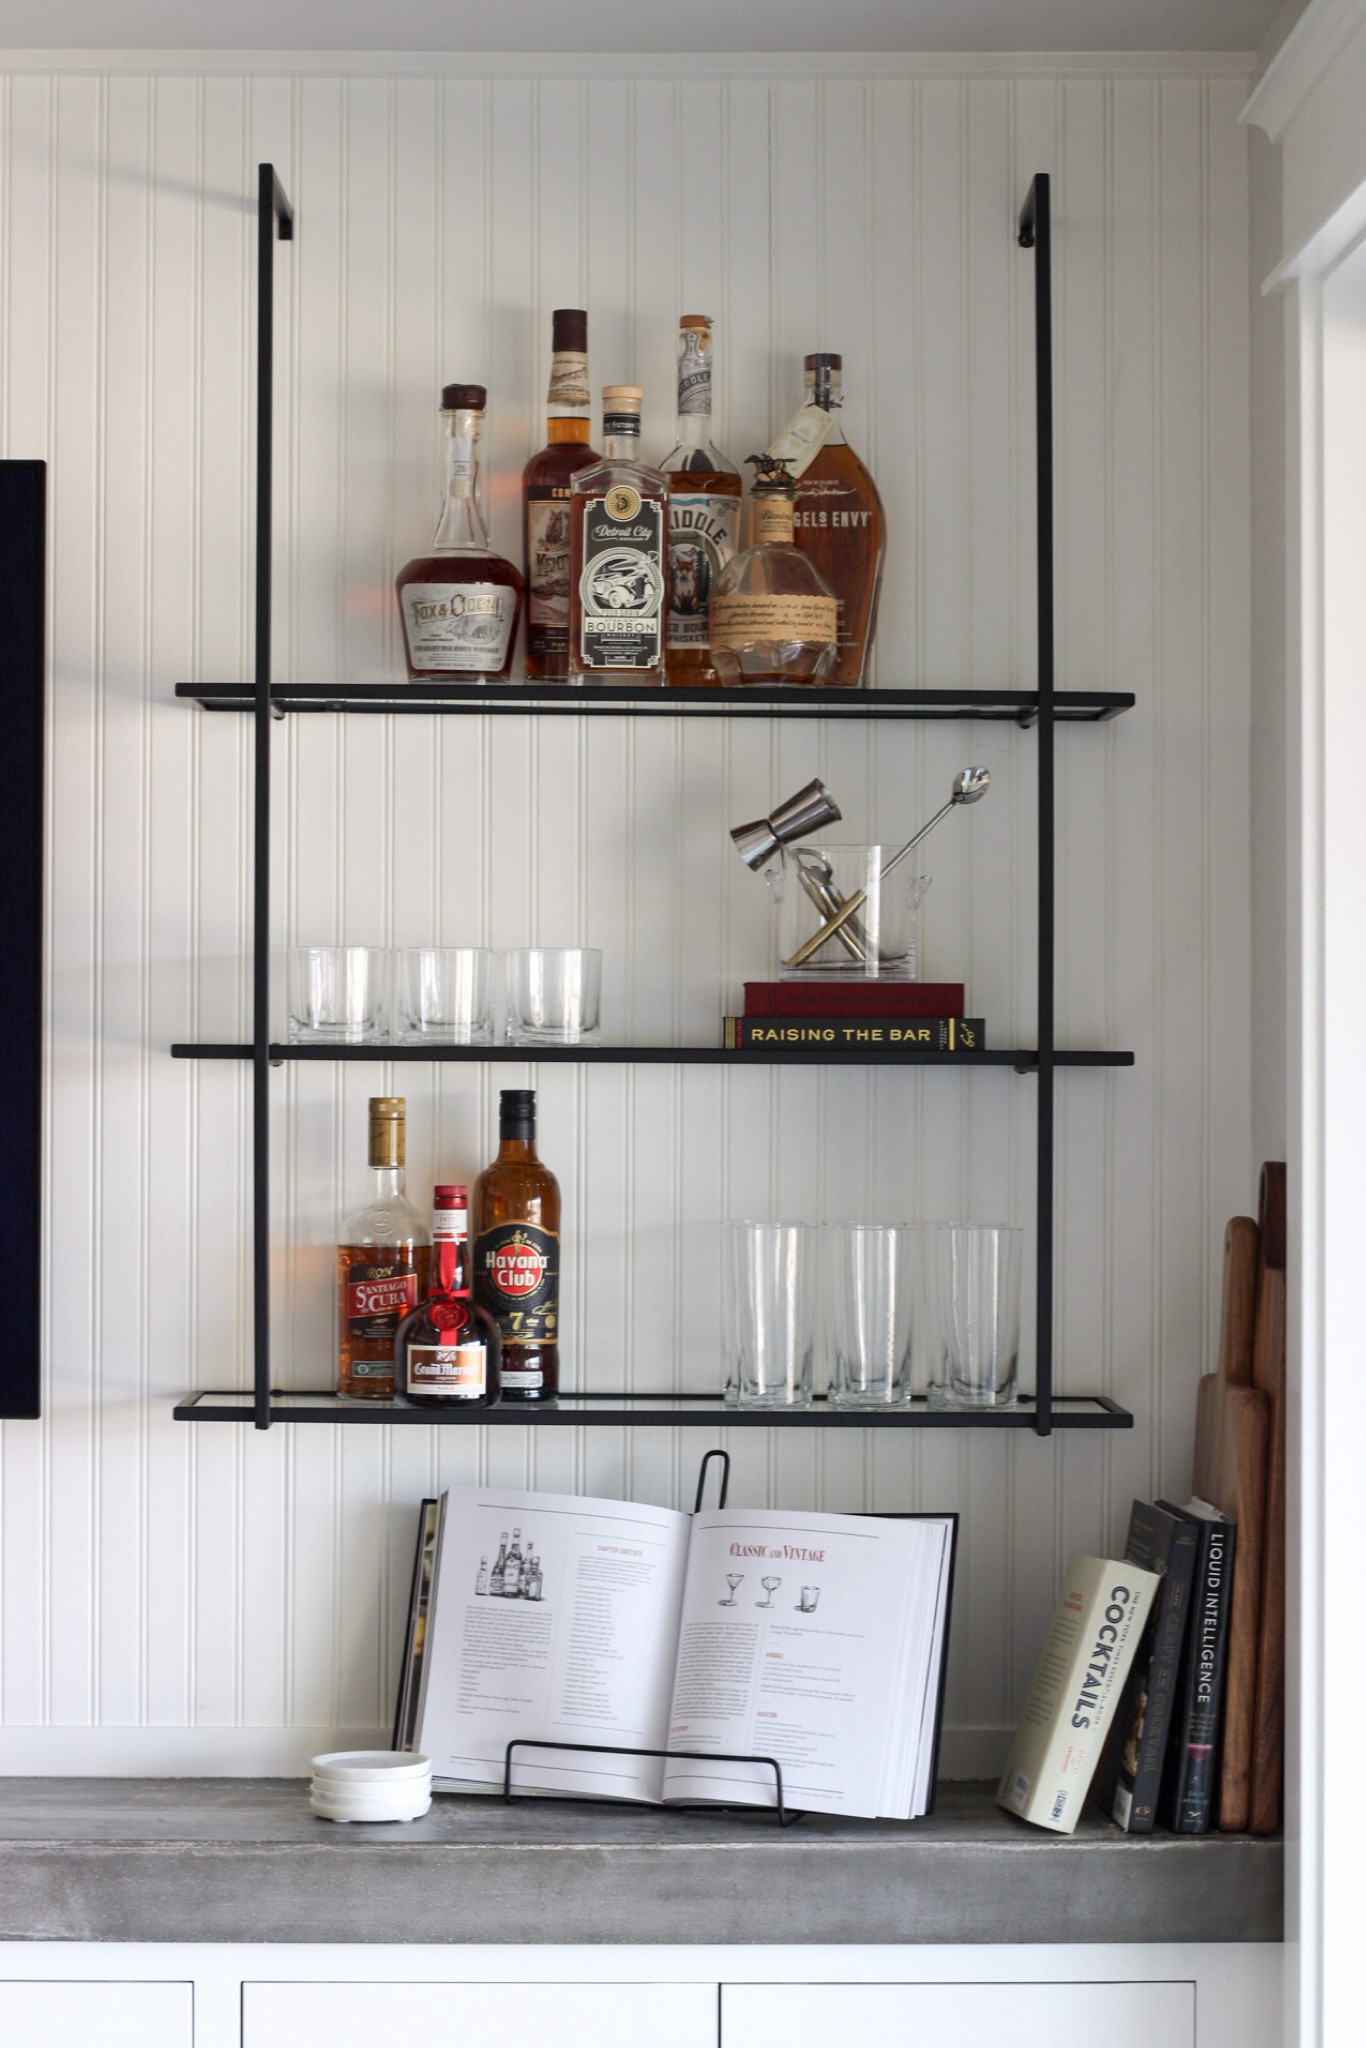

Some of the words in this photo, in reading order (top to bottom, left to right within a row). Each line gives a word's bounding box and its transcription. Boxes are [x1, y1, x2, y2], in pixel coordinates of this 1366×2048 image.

[794, 511, 828, 527] GELS
[832, 511, 868, 527] ENVY
[595, 524, 632, 537] Detroit
[633, 525, 653, 541] City
[670, 510, 728, 546] IDDLE
[587, 622, 654, 632] BOURBON
[751, 1028, 835, 1041] RAISING
[842, 1029, 883, 1041] THE
[890, 1029, 931, 1041] BAR
[485, 1251, 548, 1269] Havana
[367, 1265, 394, 1279] RON
[497, 1270, 536, 1287] Club
[508, 1312, 525, 1331] 7
[729, 1542, 768, 1557] CLASSIC
[783, 1545, 826, 1562] VINTAGE
[1207, 1533, 1224, 1589] LIQUID
[1133, 1591, 1141, 1605] THE
[1127, 1606, 1137, 1621] NEW
[1120, 1623, 1131, 1642] YORK
[1197, 1592, 1218, 1703] INTELLIGENCE
[1071, 1585, 1131, 1730] COCKTAILS
